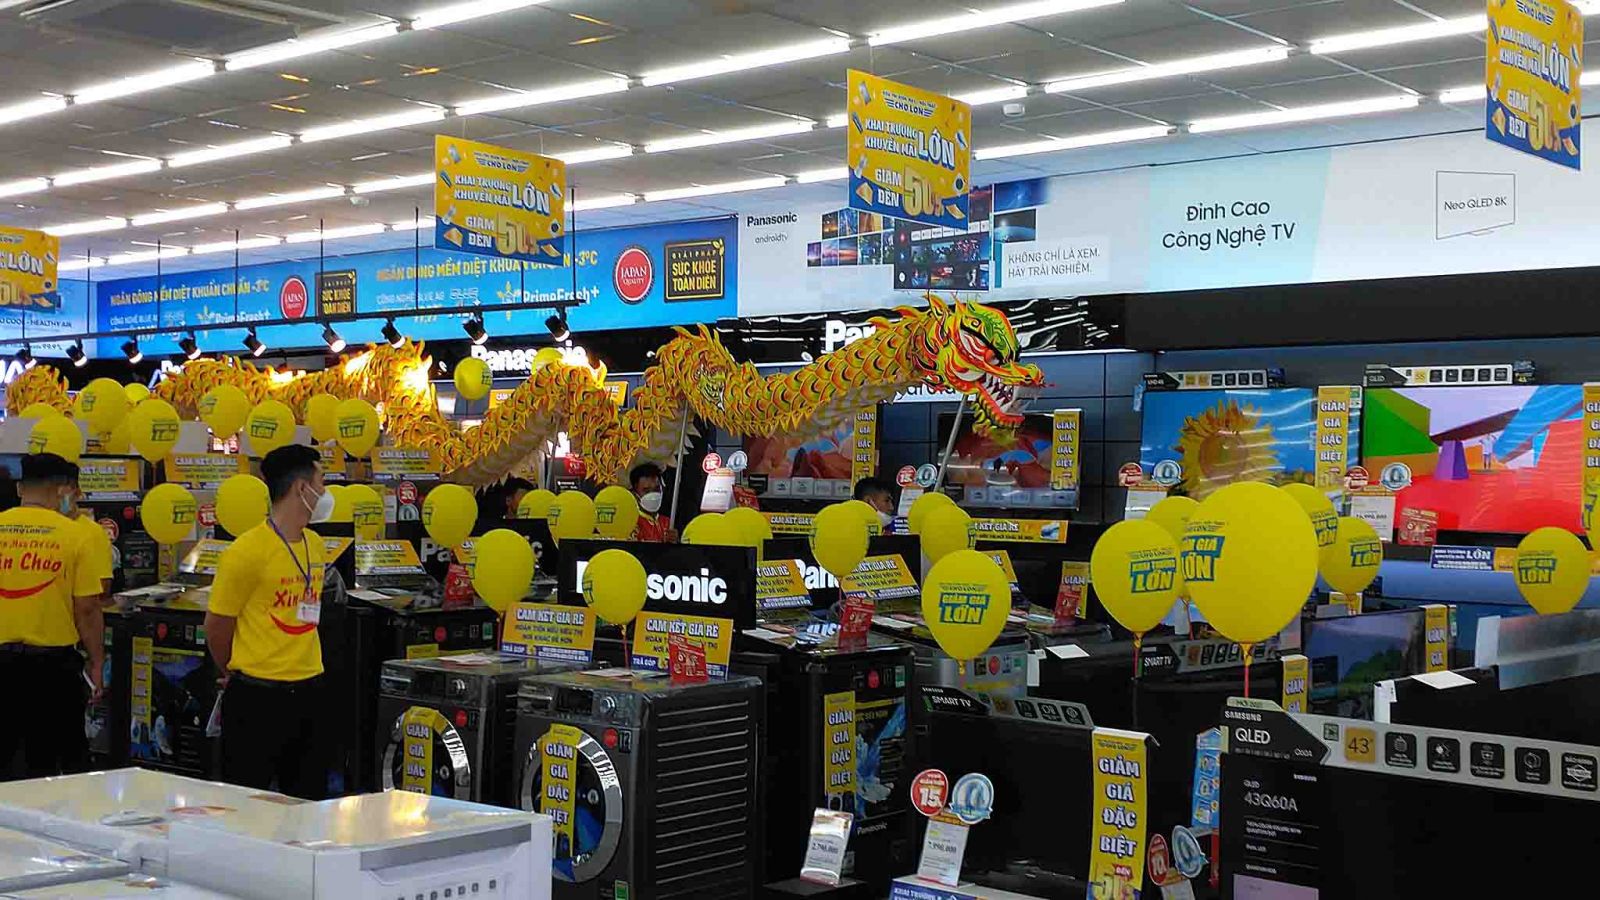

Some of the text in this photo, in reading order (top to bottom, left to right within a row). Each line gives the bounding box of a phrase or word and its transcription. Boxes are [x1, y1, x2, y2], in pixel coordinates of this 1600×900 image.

[917, 126, 955, 170] LỚN
[511, 182, 550, 216] LỚN
[877, 186, 900, 207] ĐẾN
[1444, 196, 1508, 211] Neo QLED 8K
[1231, 201, 1270, 217] Cao
[747, 212, 798, 227] Panasonic
[468, 231, 492, 248] ĐẾN
[1162, 222, 1295, 251] Công Nghệ TV
[1008, 249, 1042, 264] KHÔNG
[620, 265, 647, 279] JAPAN
[672, 261, 690, 276] SỨC
[672, 275, 695, 292] TOÀN
[1320, 400, 1346, 413] GIẢM
[1321, 433, 1343, 448] ĐẶC
[1320, 448, 1344, 463] BIỆT
[1466, 548, 1492, 560] LỚN
[1144, 656, 1173, 667] SMART TV
[931, 695, 972, 708] SMART TV
[1224, 710, 1262, 722] SAMSUNG
[1234, 727, 1271, 745] QLED
[545, 739, 574, 760] GIẢM
[550, 761, 569, 780] GIÁ
[1099, 754, 1141, 779] GIẢM
[546, 784, 570, 804] ĐẶC
[1105, 781, 1135, 802] GIÁ
[1243, 790, 1299, 812] 43Q60A
[1101, 805, 1137, 830] ĐẶC
[1099, 832, 1137, 860] BIỆT
